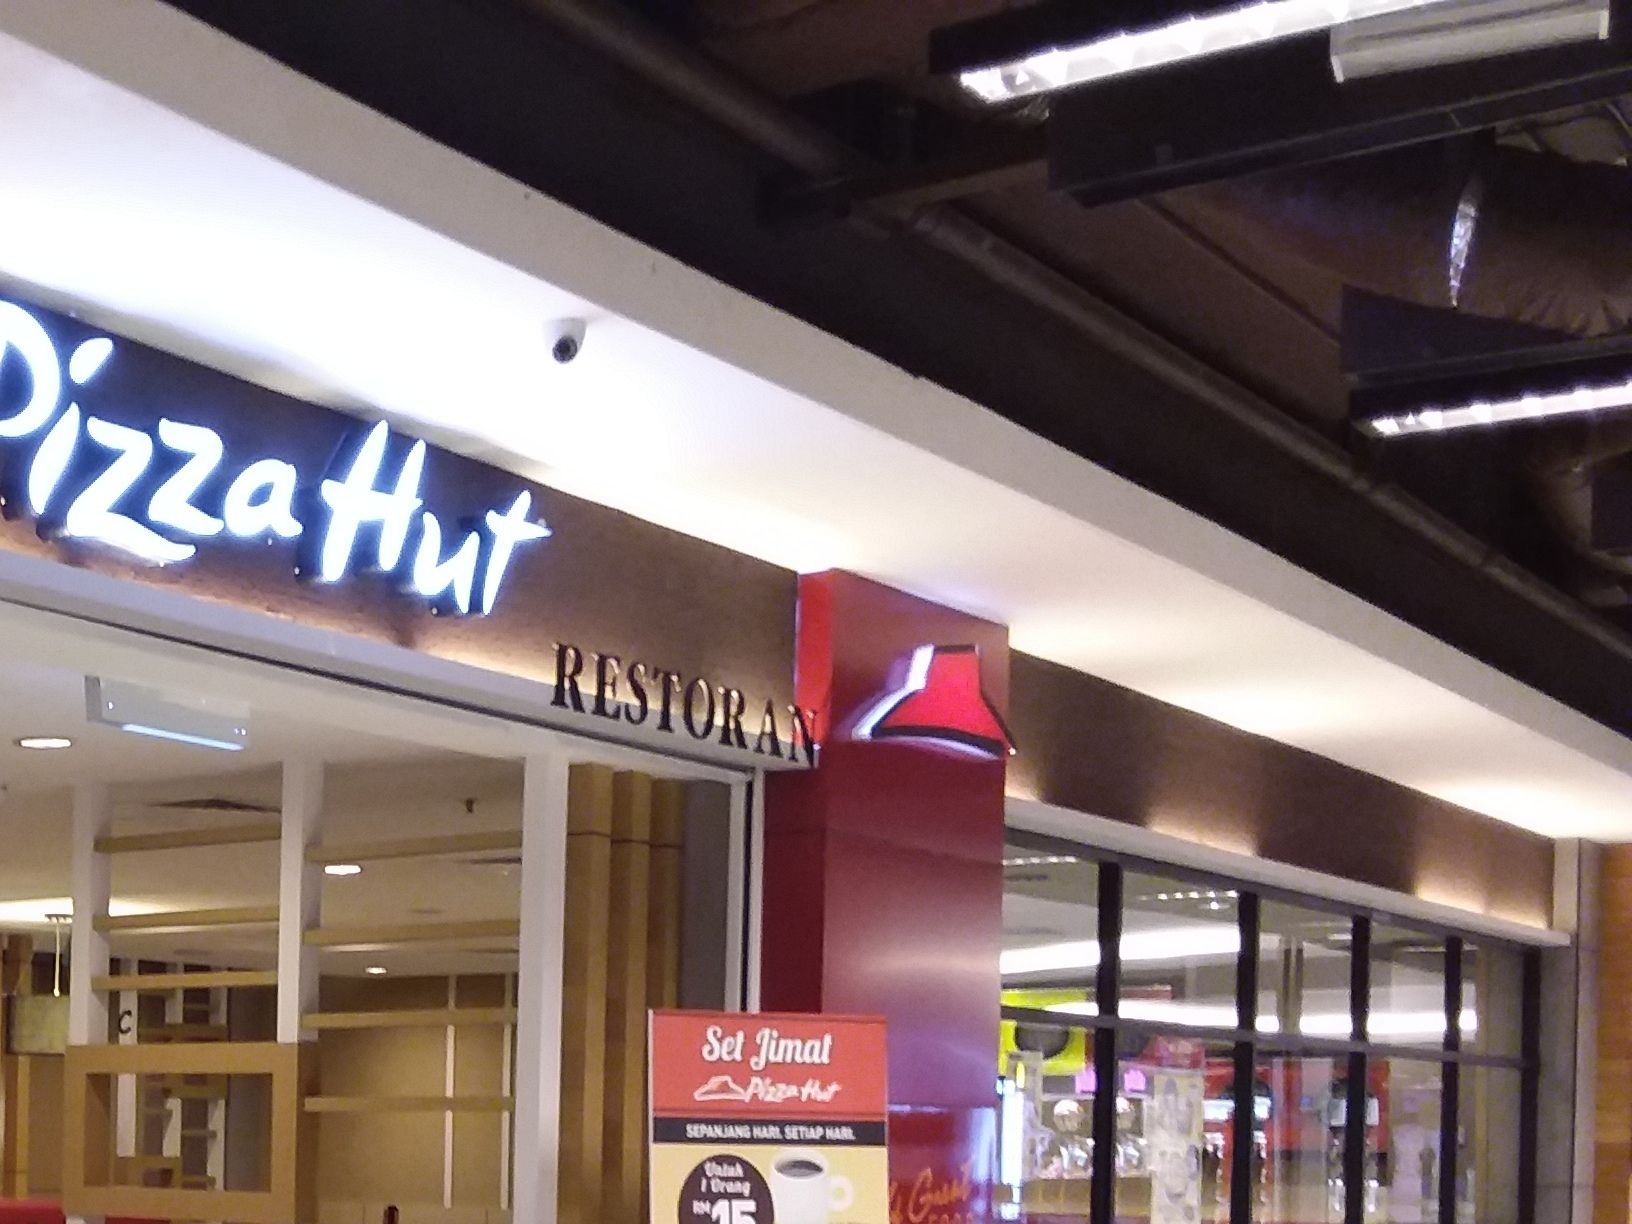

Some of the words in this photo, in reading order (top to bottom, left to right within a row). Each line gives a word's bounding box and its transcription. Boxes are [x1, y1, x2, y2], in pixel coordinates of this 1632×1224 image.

[319, 417, 555, 616] Hut
[550, 642, 820, 768] RESTORAN
[701, 1024, 746, 1063] Set
[749, 1026, 834, 1071] Jimat
[745, 1076, 799, 1103] Pizza
[799, 1078, 843, 1102] Hut
[685, 1123, 752, 1140] SEPANJANG
[784, 1125, 825, 1141] SETIAP
